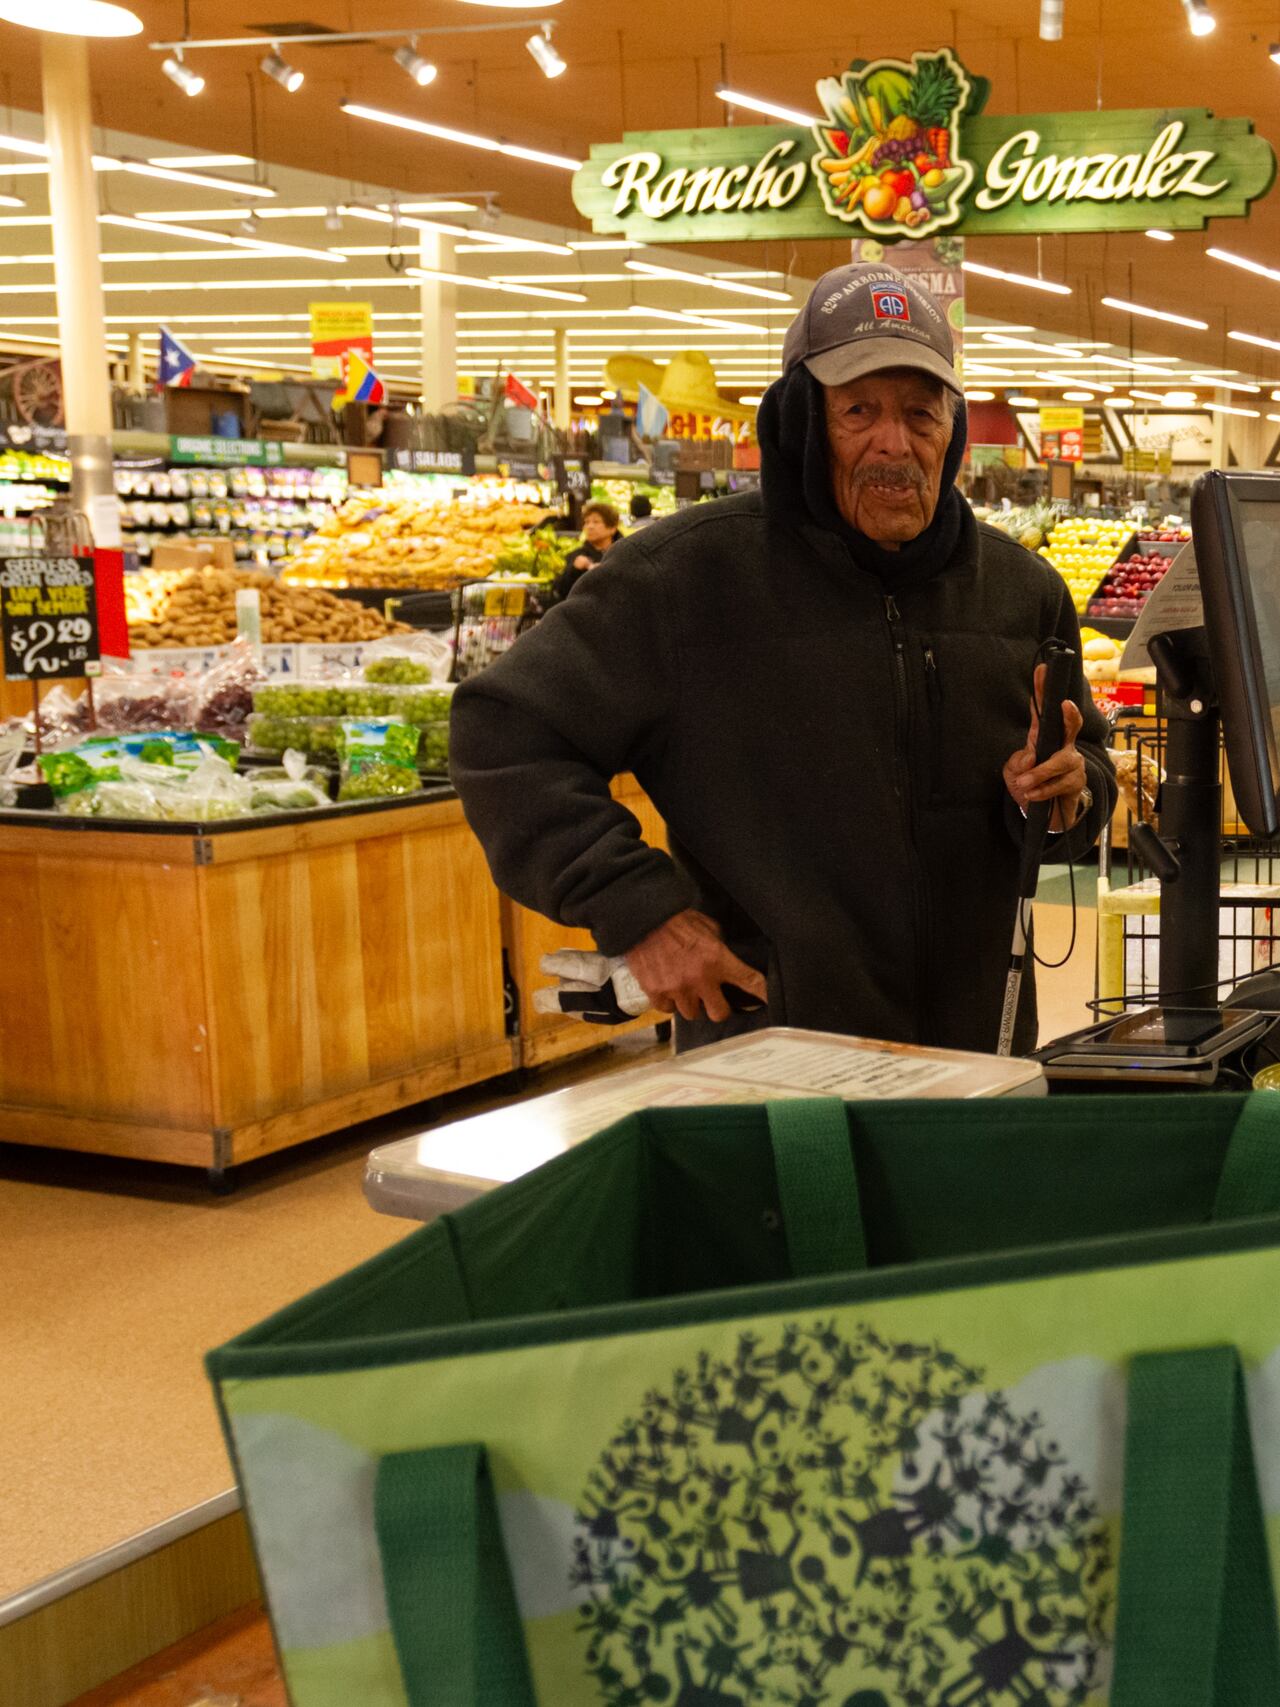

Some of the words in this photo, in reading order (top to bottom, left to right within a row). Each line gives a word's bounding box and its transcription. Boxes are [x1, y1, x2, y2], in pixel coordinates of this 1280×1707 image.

[601, 140, 807, 219] Rancho
[975, 120, 1228, 211] Gonzalez
[821, 292, 843, 314] 82ND
[842, 271, 901, 297] AIRBORNE
[853, 320, 874, 334] All
[879, 319, 932, 341] American
[415, 450, 462, 468] SALADS
